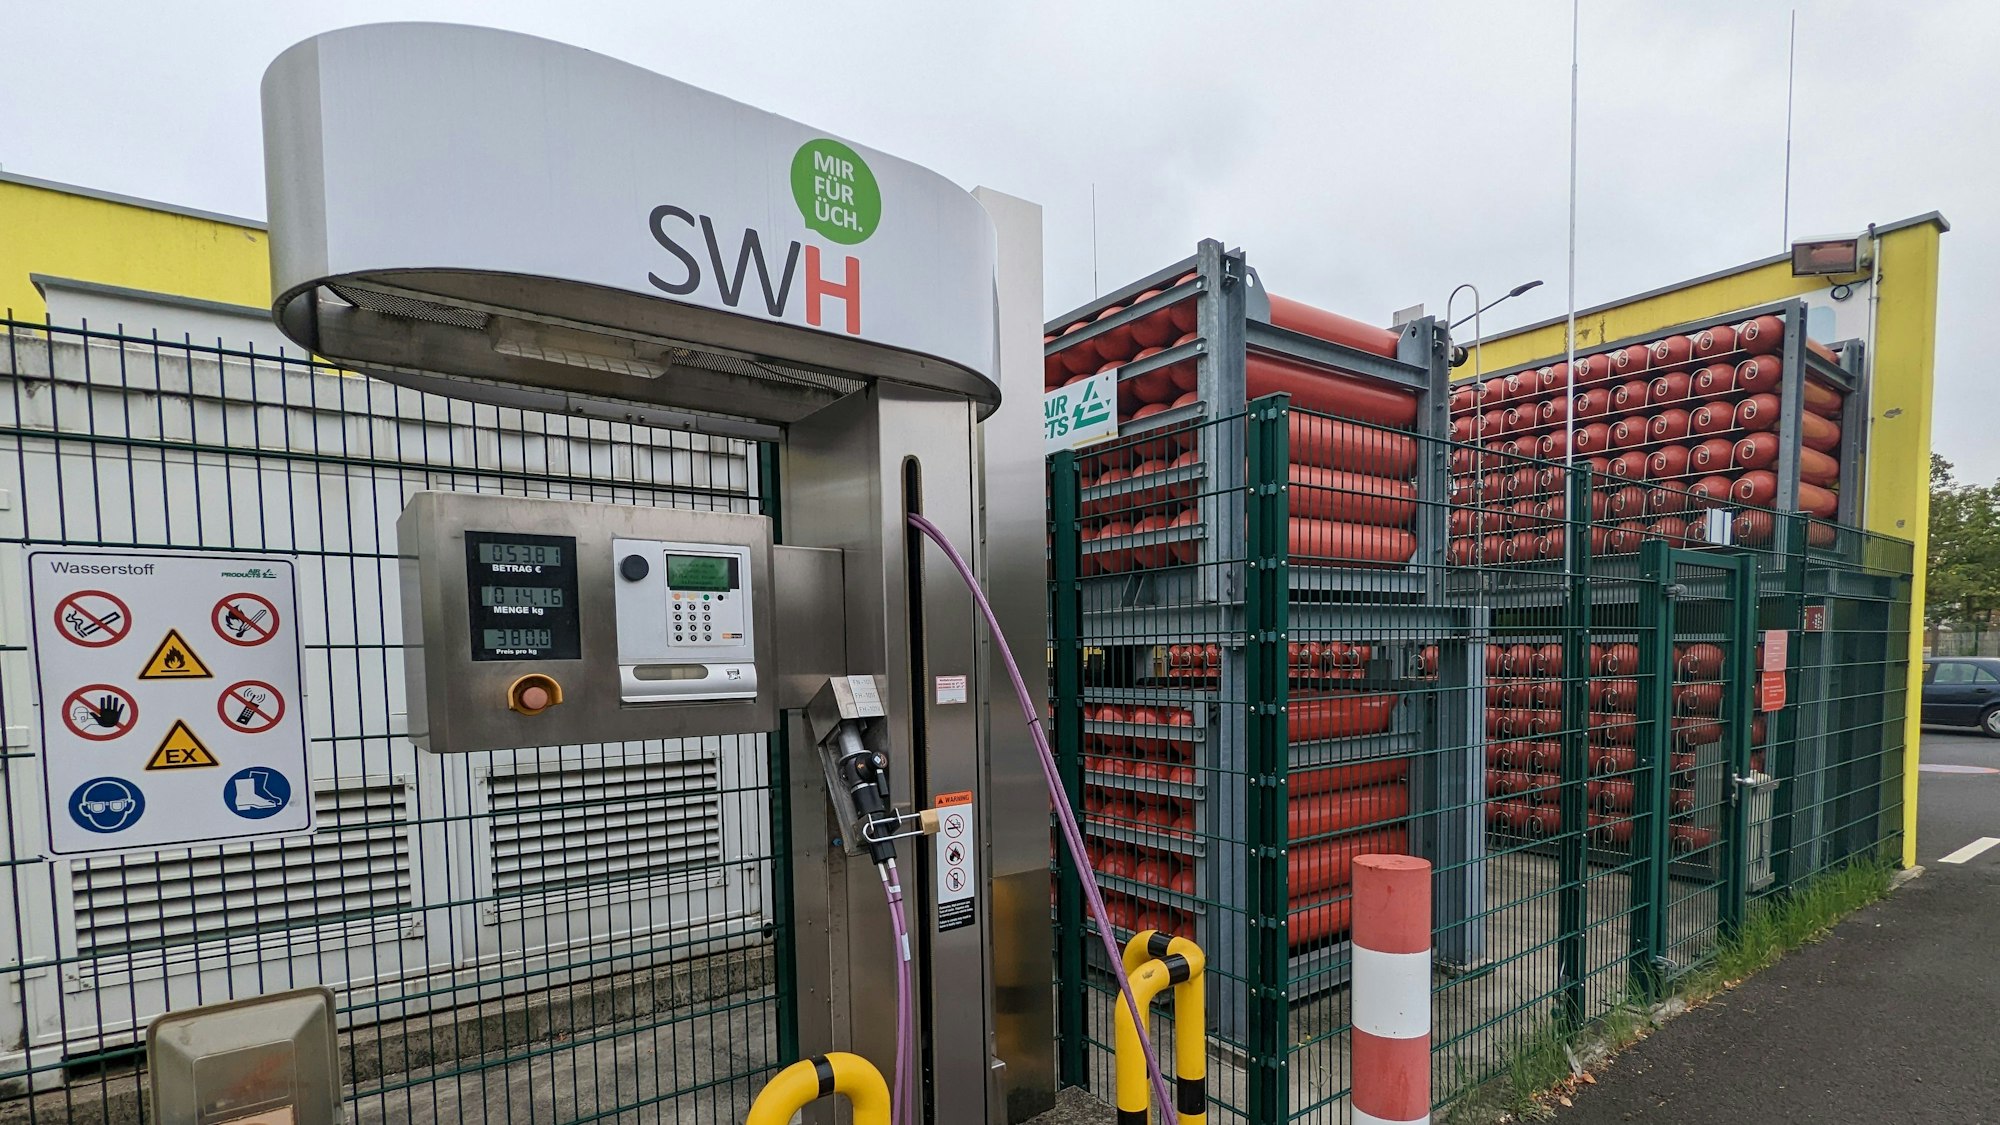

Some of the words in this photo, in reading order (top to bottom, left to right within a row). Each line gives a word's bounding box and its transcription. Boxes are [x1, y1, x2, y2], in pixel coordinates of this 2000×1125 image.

[814, 150, 855, 182] MIR
[814, 174, 854, 206] FÜR
[814, 200, 864, 232] ÜCH.
[648, 204, 861, 336] SWH
[51, 561, 155, 576] Wasserstoff
[492, 564, 532, 573] BETRAG
[532, 607, 544, 615] kg
[166, 748, 198, 764] EX
[945, 794, 969, 803] WARNING
